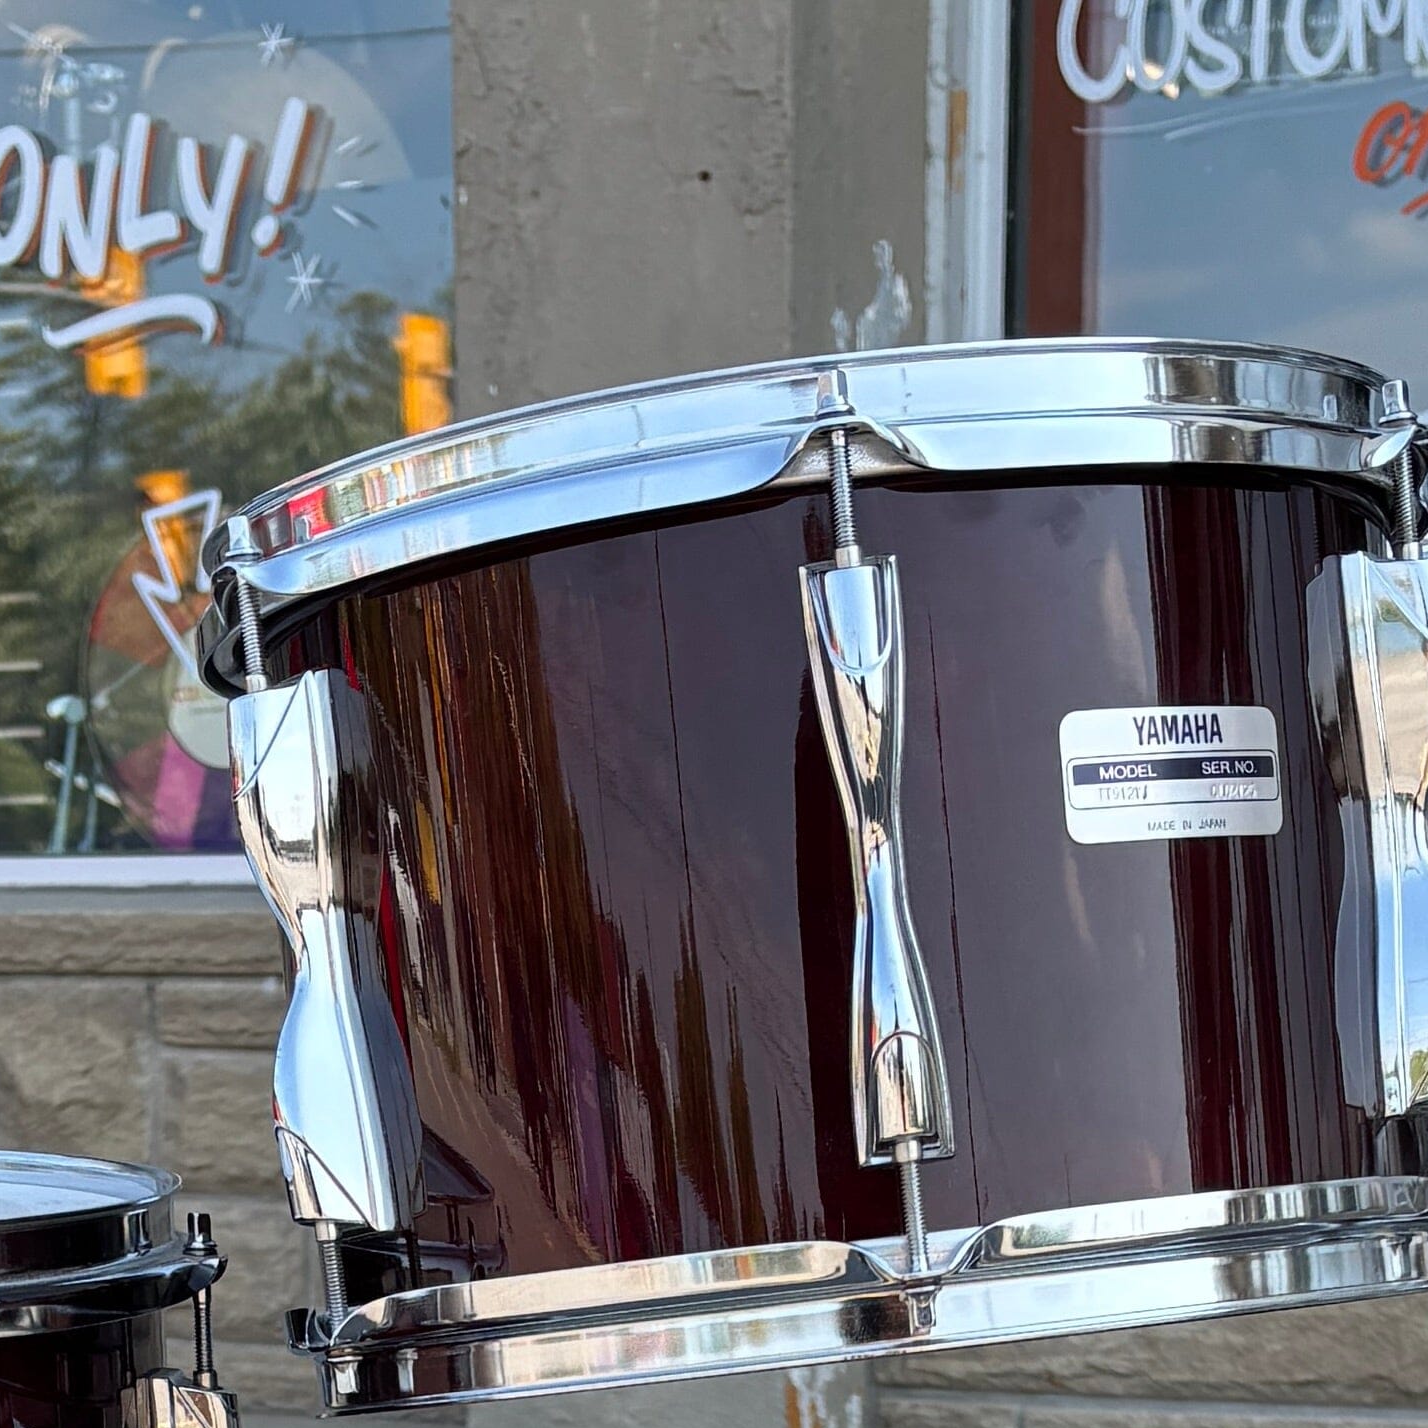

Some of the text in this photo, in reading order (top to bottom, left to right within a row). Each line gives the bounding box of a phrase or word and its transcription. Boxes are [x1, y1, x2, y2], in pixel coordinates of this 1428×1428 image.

[1132, 712, 1224, 747] YAMAHA
[1099, 759, 1259, 781] MODEL SER.NO.
[1147, 817, 1227, 832] MADE IN JAPAN
